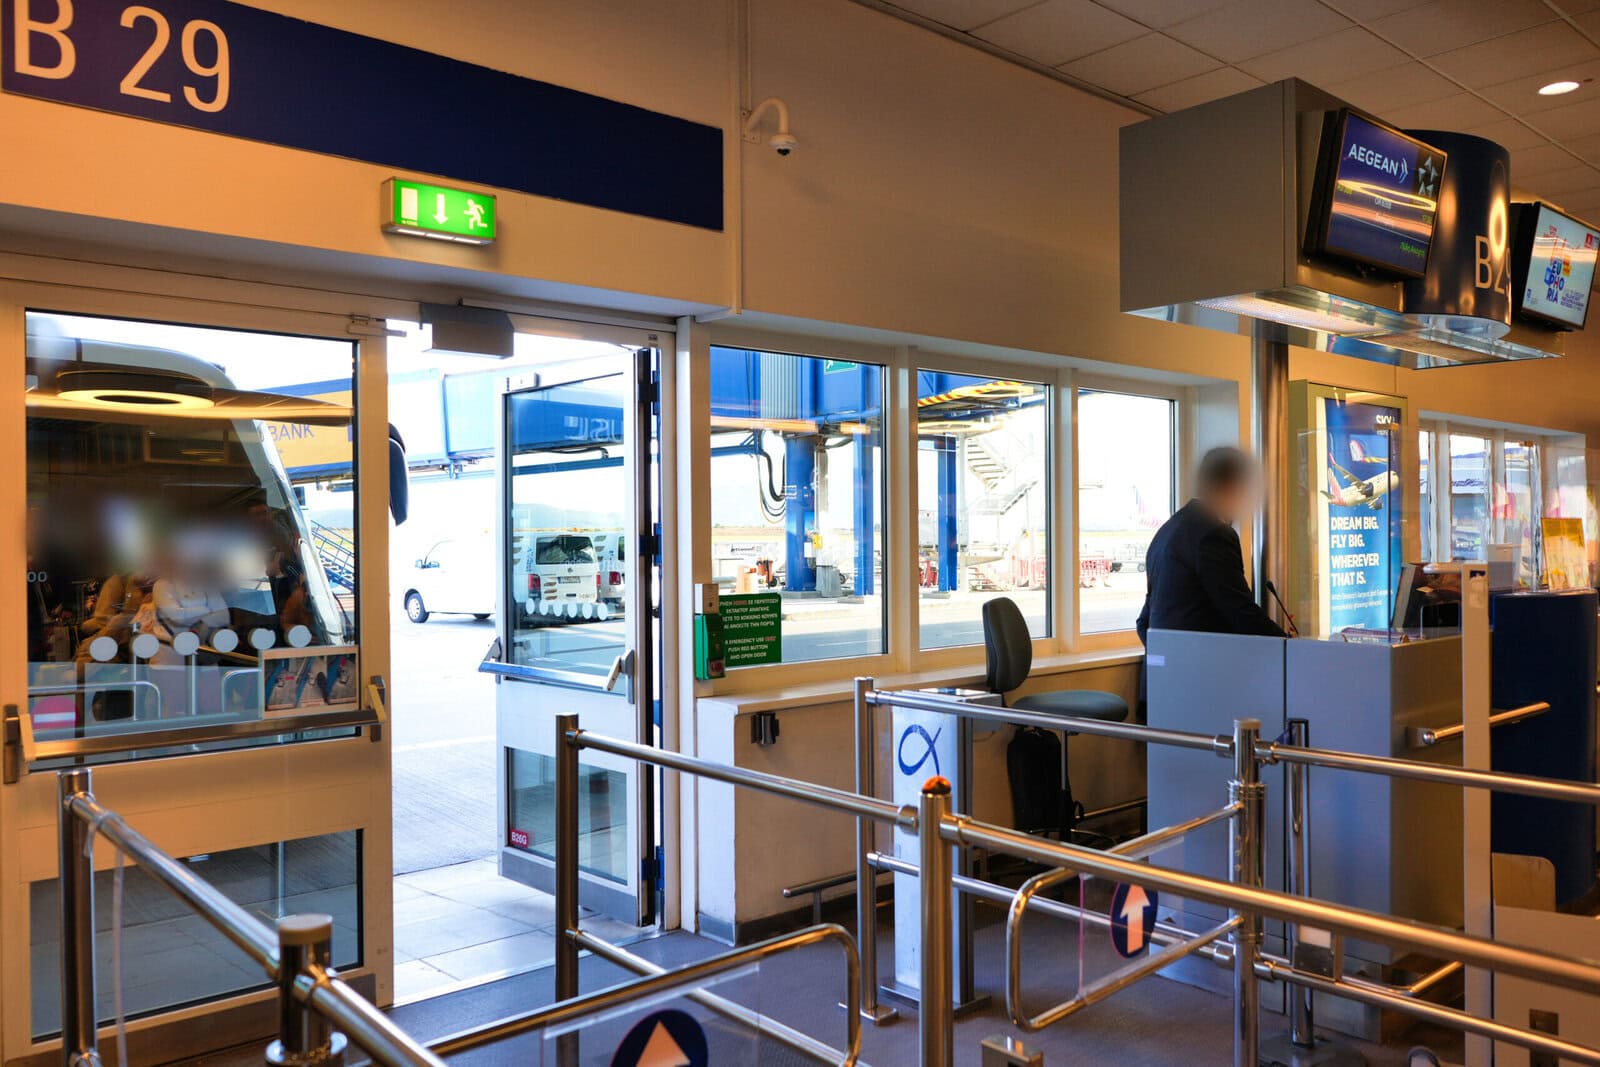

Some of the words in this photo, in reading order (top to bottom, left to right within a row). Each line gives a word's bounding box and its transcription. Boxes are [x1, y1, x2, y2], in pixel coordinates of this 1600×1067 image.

[14, 0, 77, 80] B
[119, 5, 230, 113] 29
[1348, 143, 1399, 177] AEGEAN
[268, 423, 314, 441] BANK
[1331, 516, 1362, 530] DREAM
[1363, 516, 1379, 530] BIG.
[1331, 534, 1347, 548] FLY
[1348, 533, 1365, 547] BIG.
[1331, 552, 1380, 568] WHEREVER
[1331, 572, 1355, 586] THAT
[1356, 571, 1367, 585] IS.
